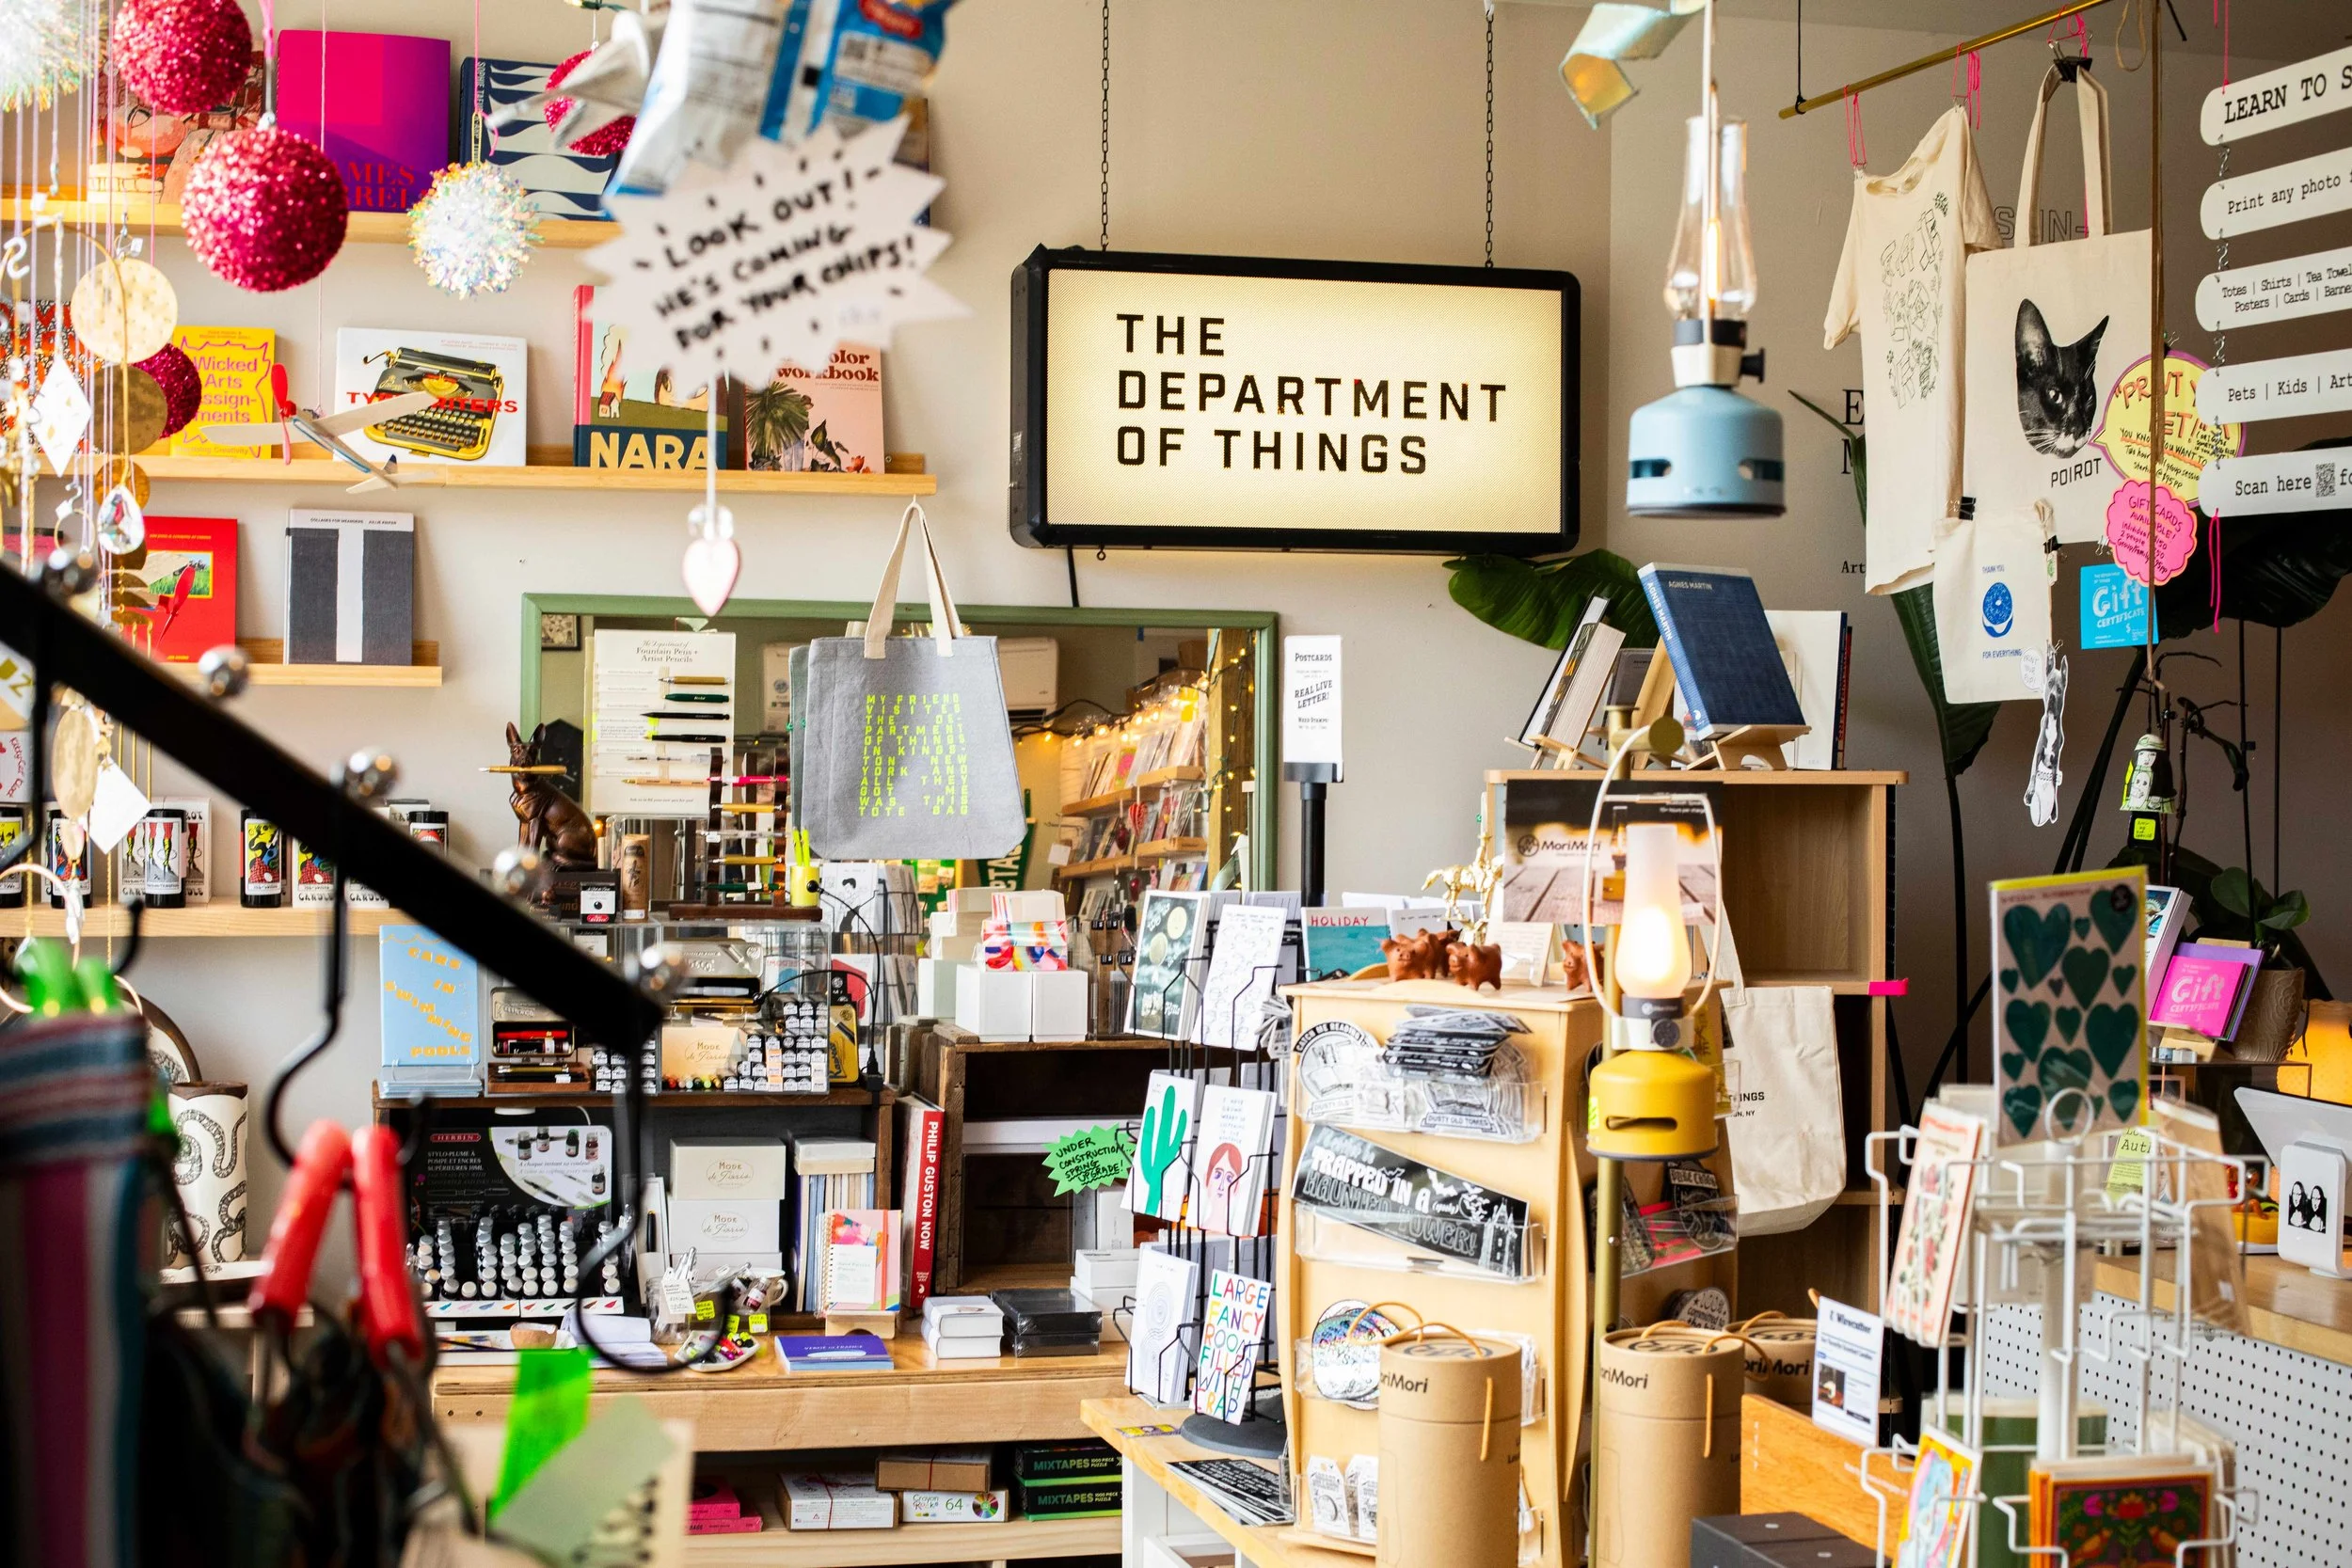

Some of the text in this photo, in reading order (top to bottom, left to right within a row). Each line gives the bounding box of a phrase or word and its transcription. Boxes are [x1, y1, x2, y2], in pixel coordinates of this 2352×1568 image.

[2224, 73, 2327, 124] LEARN TO
[2228, 175, 2341, 215] Print any photo
[665, 168, 856, 268] LOOK OUT!
[733, 223, 853, 280] COMING
[675, 310, 735, 349] FOR
[821, 233, 915, 285] CHIPS!
[2222, 285, 2248, 298] Totes
[2261, 277, 2292, 292] Shirts
[2306, 271, 2322, 284] Tea
[2234, 290, 2310, 312] Posters Cards
[1116, 313, 1225, 356] THE
[193, 356, 258, 372] Wicked
[829, 350, 870, 364] olor
[205, 374, 242, 388] Arts
[2228, 387, 2256, 402] Pets
[2278, 379, 2307, 395] Kids
[200, 391, 257, 409] ssign-
[1118, 370, 1506, 423] DEPARTMENT
[590, 432, 718, 470] NARA
[1117, 426, 1427, 474] OF THINGS
[2120, 428, 2207, 467] YOU WANT TO
[2051, 458, 2102, 487] POIROT
[2235, 475, 2312, 496] Scan here
[2129, 496, 2183, 532] GIFT CARDS
[2092, 579, 2142, 617] Gift
[1646, 581, 1674, 641] AGNES MARTIN
[2097, 607, 2146, 628] CERTIFICATE
[1993, 649, 2022, 658] EVERYTHING
[866, 693, 959, 705] MY FRIEND
[1295, 680, 1333, 699] REAL LIVE
[1297, 691, 1329, 709] LETTER!
[865, 724, 963, 736] PARTMENT
[866, 715, 895, 725] THE
[864, 734, 965, 746] OF THINGS
[863, 754, 967, 766] TON NEW
[864, 746, 881, 756] IN
[861, 775, 967, 786] ALL THEY
[862, 765, 967, 776] YORK AND
[859, 796, 968, 807] WAS THIS
[860, 785, 968, 797] GOT ME
[859, 805, 968, 817] TOTE BAG
[1311, 915, 1370, 927] HOLIDAY
[407, 947, 462, 970] CARS
[434, 978, 456, 994] IN
[2171, 974, 2225, 1004] Gift
[410, 1045, 471, 1058] POOLS
[697, 1042, 721, 1051] MODE
[1056, 1137, 1096, 1158] UNDER
[718, 1162, 742, 1170] MODE
[1065, 1160, 1100, 1180] SPRING
[1078, 1160, 1123, 1182] UPGRADE!
[919, 1120, 939, 1251] PHILIP GUSTON NOW
[1311, 1146, 1388, 1196] TRAPPED
[1391, 1178, 1413, 1206] IN
[1415, 1187, 1431, 1213] A
[714, 1214, 738, 1223] MODE
[1212, 1273, 1267, 1309] LARGE
[1208, 1300, 1264, 1337] FANCY
[1204, 1325, 1252, 1359] ROOM
[1201, 1346, 1252, 1381] FILLED
[1600, 1367, 1649, 1389] oriMori
[1194, 1386, 1238, 1417] CRAP
[1033, 1457, 1089, 1471] MIXTAPES
[913, 1494, 962, 1511] Crayon 64
[1038, 1493, 1094, 1506] MIXTAPES
